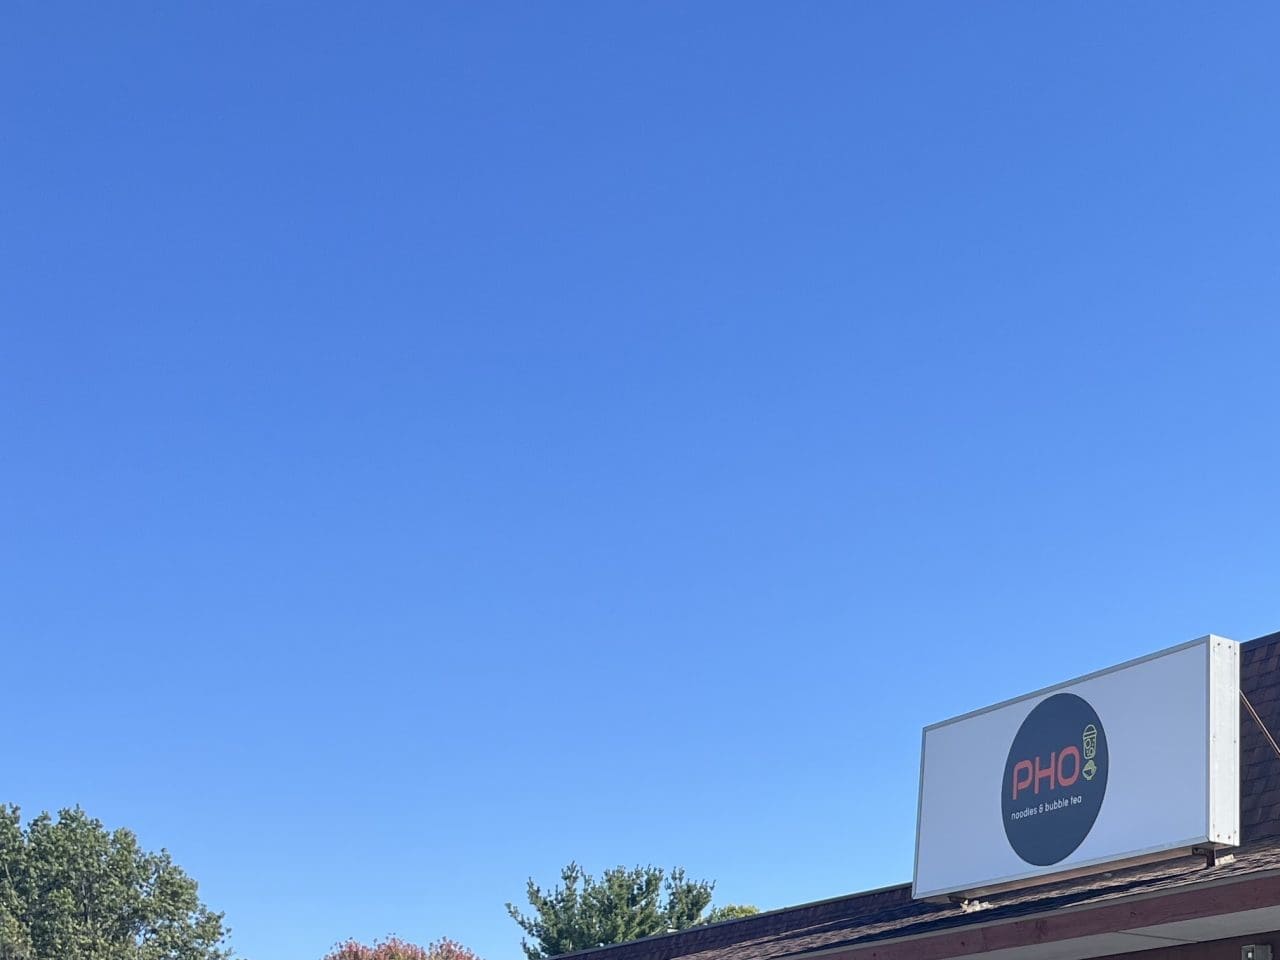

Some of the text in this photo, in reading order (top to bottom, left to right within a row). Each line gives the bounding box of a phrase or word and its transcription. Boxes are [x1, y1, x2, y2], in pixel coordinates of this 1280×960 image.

[1012, 746, 1082, 800] PHO
[1011, 806, 1038, 820] noodles
[1045, 798, 1069, 812] bubble
[1070, 795, 1082, 806] tea
